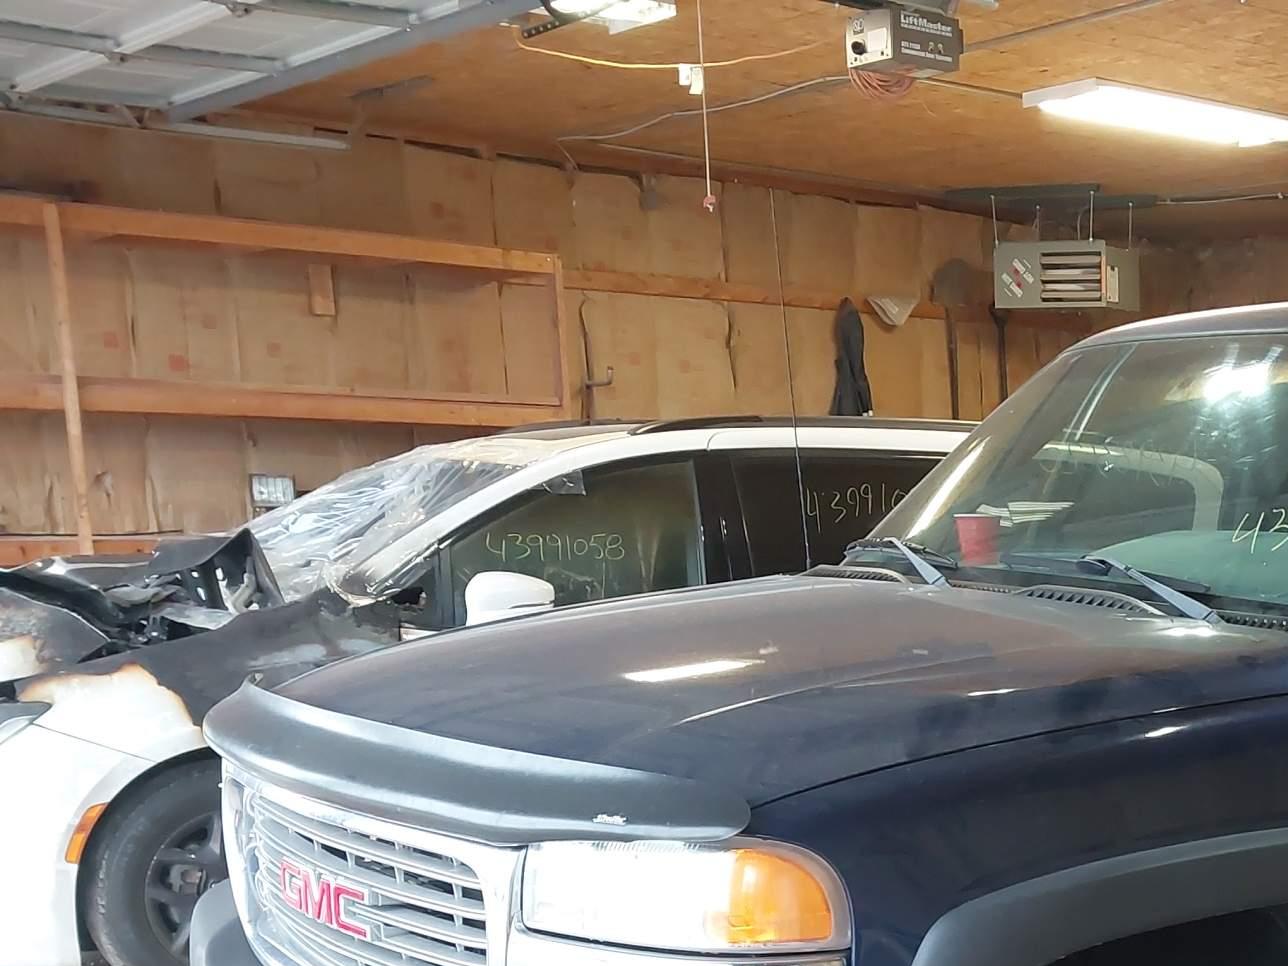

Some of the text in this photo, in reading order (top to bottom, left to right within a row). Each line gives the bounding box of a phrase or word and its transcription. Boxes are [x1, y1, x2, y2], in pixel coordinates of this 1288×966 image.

[900, 13, 952, 32] LiftMaster
[486, 532, 625, 562] 43991058
[280, 857, 368, 940] GMC
